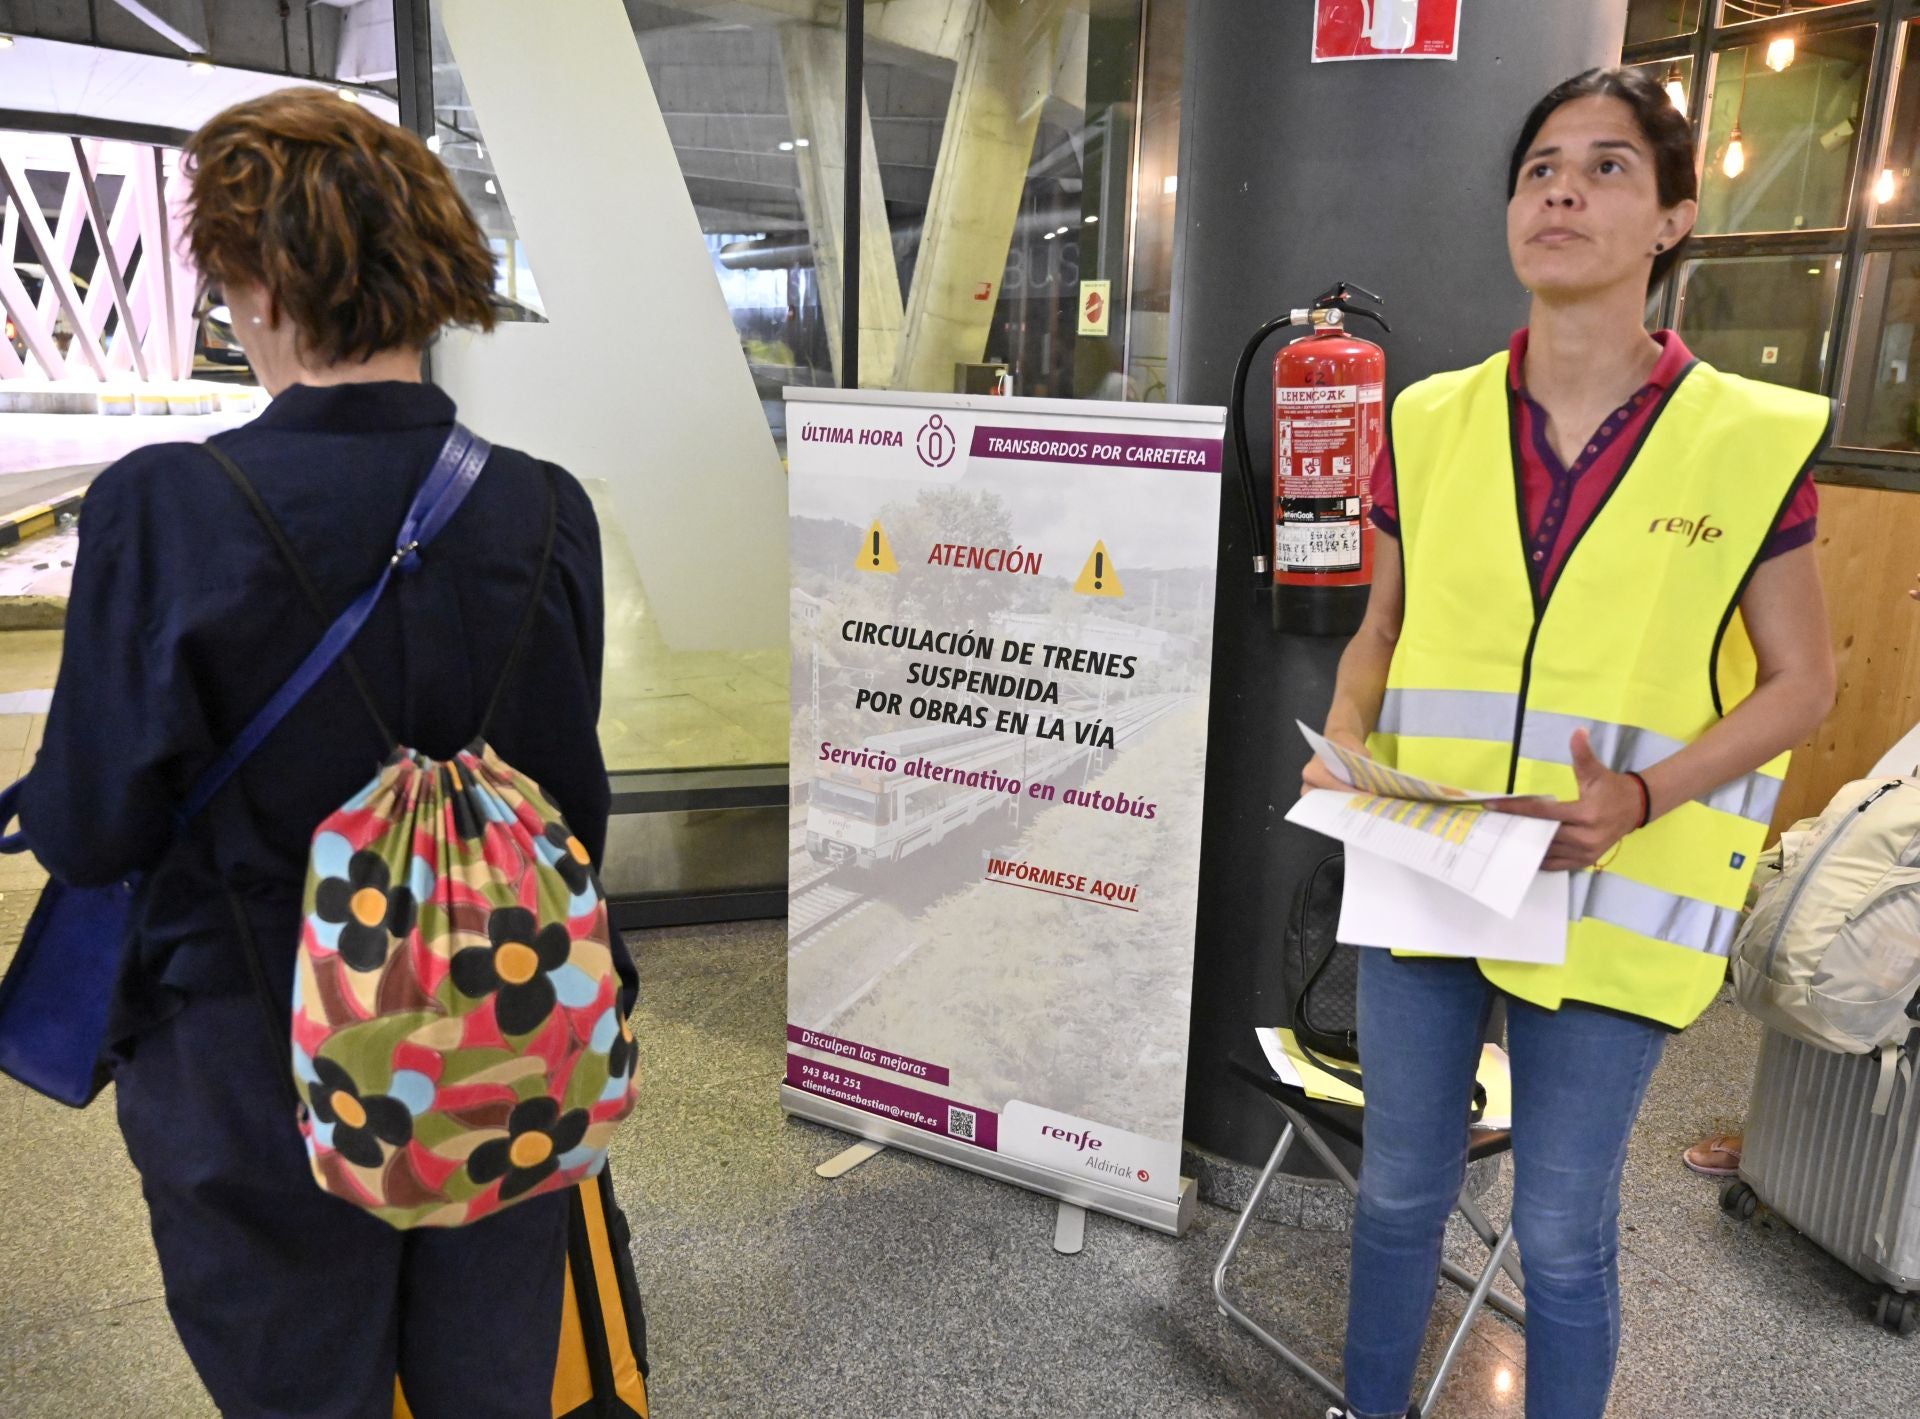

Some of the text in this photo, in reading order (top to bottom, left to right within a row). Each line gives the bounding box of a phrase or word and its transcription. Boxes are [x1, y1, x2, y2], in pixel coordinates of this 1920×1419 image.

[801, 421, 904, 448] ÚLTIMA HORA
[987, 437, 1207, 467] TRANSBORDOS POR CARRETERA
[1648, 514, 1723, 548] renfe
[928, 543, 1043, 576] ATENCIÓN
[841, 620, 1138, 679] CIRCULACIÓN DE TRENES
[906, 662, 1060, 705] SUSPENDIDA
[855, 688, 1116, 750] POR OBRAS EN LA VÍA
[818, 741, 1158, 820] Servicio alternativo en autobús
[987, 857, 1139, 904] INFÓRMESE AQUÍ
[801, 1031, 928, 1076] Disculpen las mejoras
[802, 1065, 861, 1090] 943 841 251
[801, 1079, 938, 1127] clientesansebastian@renfe.es
[1041, 1124, 1103, 1152] renfe
[1085, 1156, 1133, 1180] Aldiriak
